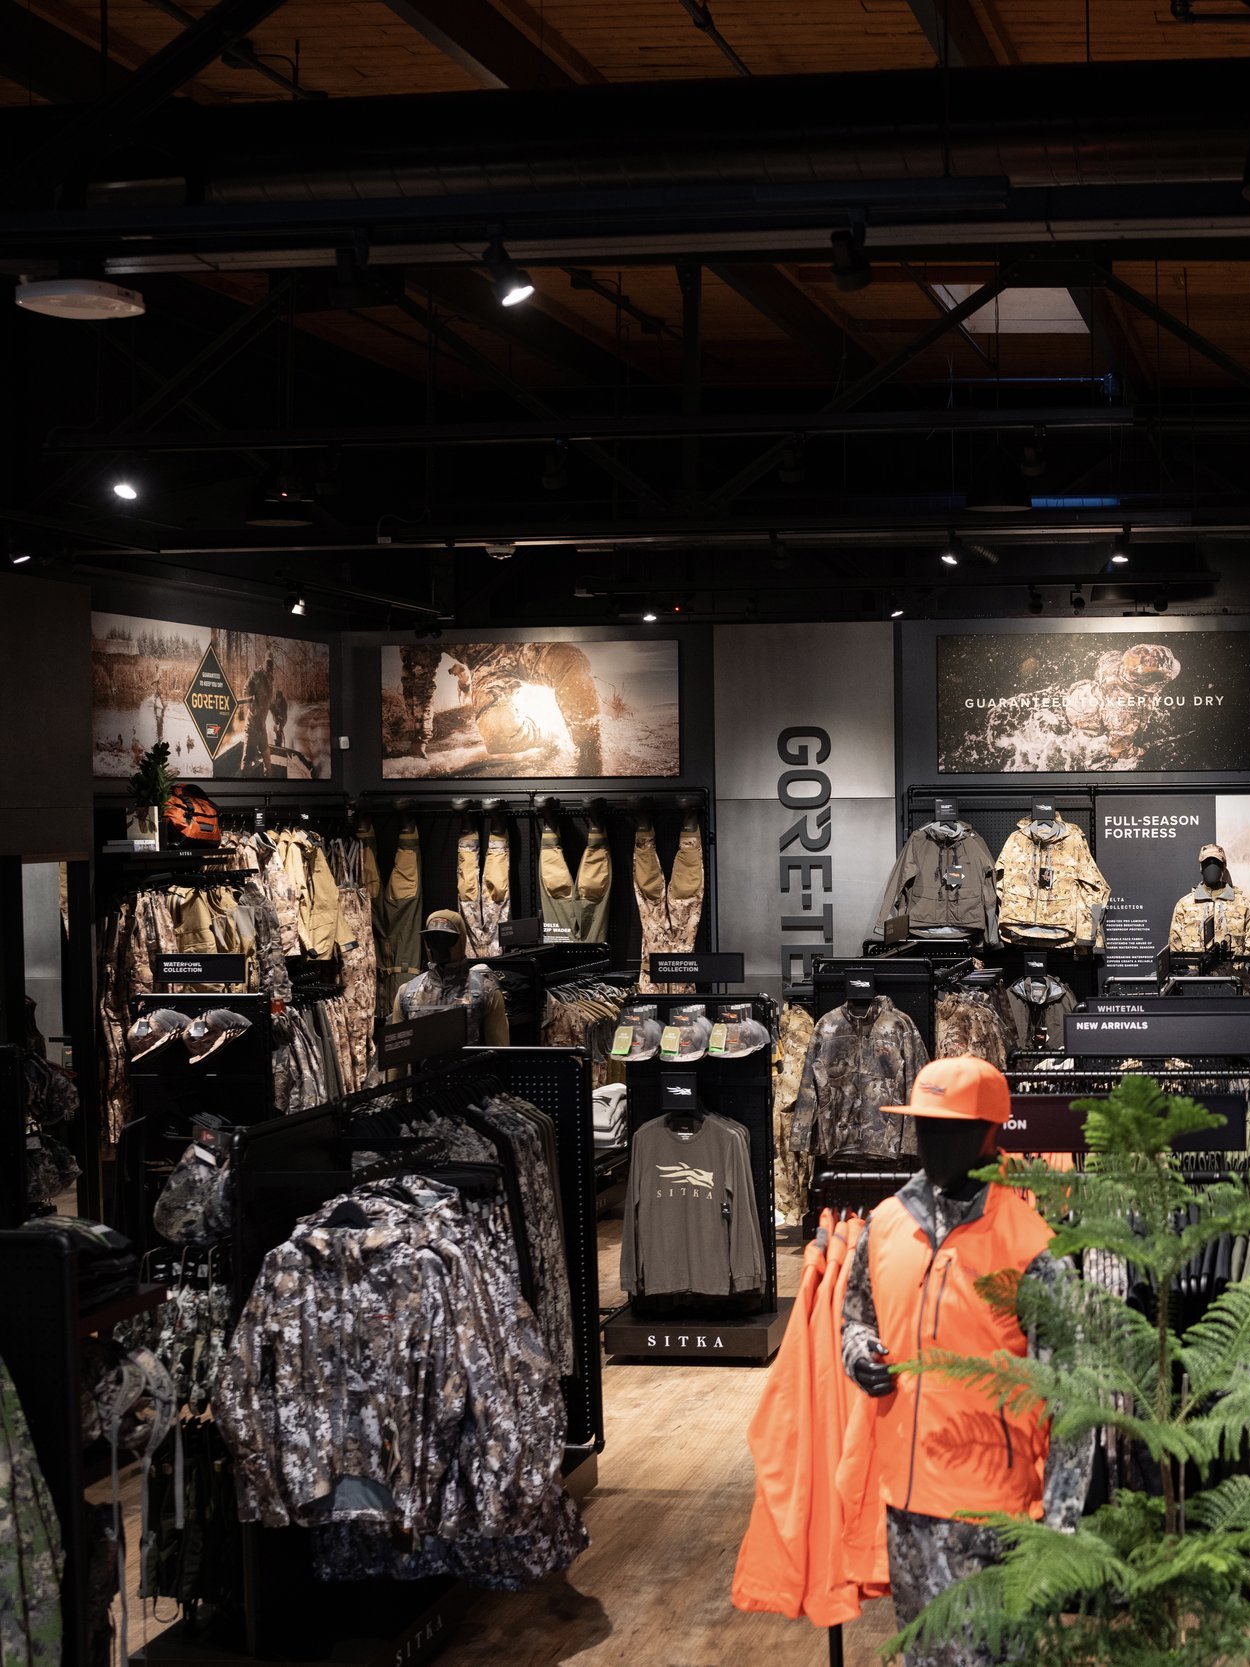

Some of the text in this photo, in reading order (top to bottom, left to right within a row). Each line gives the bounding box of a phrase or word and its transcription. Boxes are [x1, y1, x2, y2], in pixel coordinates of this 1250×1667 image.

[192, 692, 230, 710] GORE-TEX
[964, 696, 1225, 708] GUARANTEED TO KEEP YOU DRY
[1104, 816, 1200, 826] FULL-SEASON
[1104, 828, 1177, 839] FORTRESS
[777, 726, 833, 990] GORE-TE
[1076, 1022, 1148, 1030] NEW ARRIVALS
[656, 1188, 713, 1200] SITKA
[647, 1335, 724, 1348] SITKA
